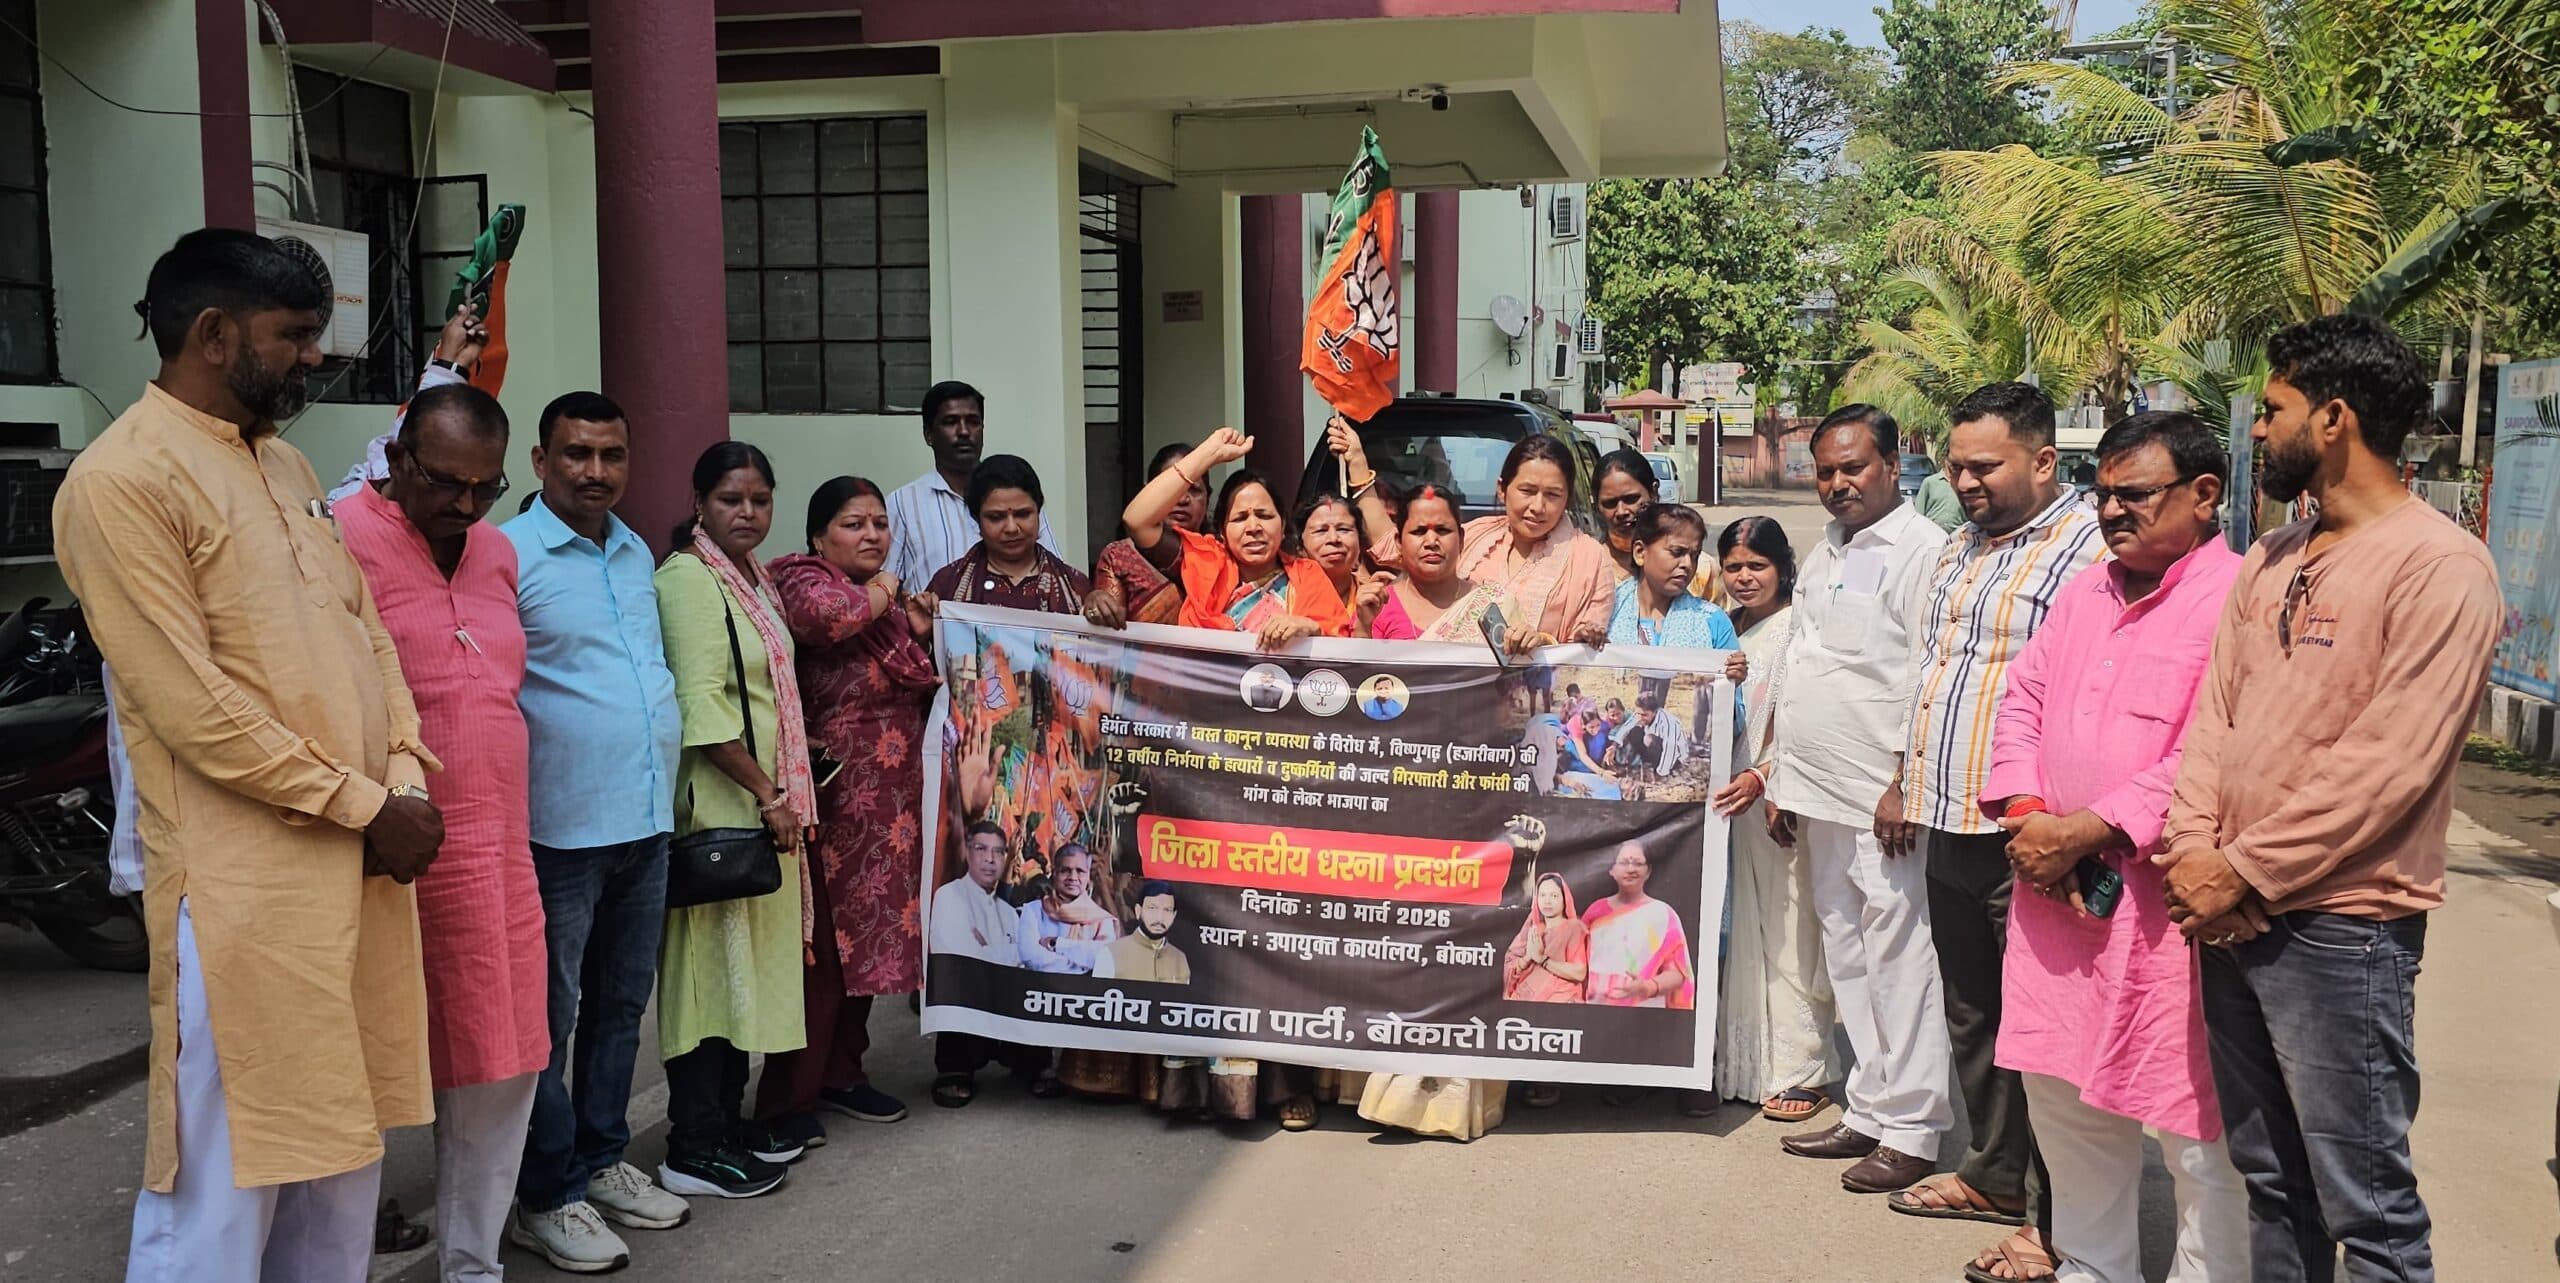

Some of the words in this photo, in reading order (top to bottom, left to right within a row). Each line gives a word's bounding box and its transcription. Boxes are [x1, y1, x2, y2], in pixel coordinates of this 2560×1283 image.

[1101, 716, 1129, 735] हेमंत
[1132, 721, 1173, 739] सरकार
[1175, 722, 1188, 740] में
[1192, 726, 1222, 744] ध्वस्त
[1223, 728, 1262, 750] कानून
[1266, 731, 1310, 750] व्यवस्था
[1313, 732, 1327, 751] के
[1329, 733, 1364, 754] विरोध
[1368, 736, 1385, 758] में,
[1446, 742, 1516, 768] (हजारीबाग)
[1520, 745, 1538, 765] की
[1106, 748, 1123, 763] 12
[1127, 746, 1160, 765] वर्षीय
[1164, 749, 1204, 770] निर्भया
[1208, 755, 1222, 771] के
[1224, 753, 1264, 775] हत्यारों
[1267, 760, 1277, 776] व
[1280, 760, 1336, 783] दुष्कर्मियों
[1338, 763, 1356, 782] की
[1359, 767, 1390, 785] जल्द
[1452, 770, 1477, 790] और
[1479, 768, 1511, 792] फांसी
[1513, 774, 1531, 793] की
[1243, 784, 1269, 802] मांग
[1272, 786, 1289, 805] को
[1292, 789, 1324, 807] लेकर
[1327, 794, 1369, 812] भाजपा
[1371, 796, 1389, 812] का
[1150, 820, 1221, 869] जिला
[1227, 831, 1311, 878] स्तरीय
[1317, 850, 1387, 883] धरना
[1393, 845, 1483, 891] प्रदर्शन
[1241, 889, 1301, 915] दिनांक
[1320, 901, 1347, 921] 30
[1353, 900, 1391, 925] मार्च
[1397, 907, 1451, 928] 2026
[1199, 925, 1246, 949] स्थान
[1266, 931, 1338, 961] उपायुक्त
[1343, 936, 1429, 968] कार्यालय,
[1435, 942, 1496, 968] बोकारो
[1023, 988, 1152, 1024] भारतीय
[1160, 1001, 1261, 1034] जनता
[1269, 1006, 1355, 1043] पार्टी,
[1365, 1012, 1488, 1049] बोकारो
[1495, 1017, 1584, 1054] जिला
